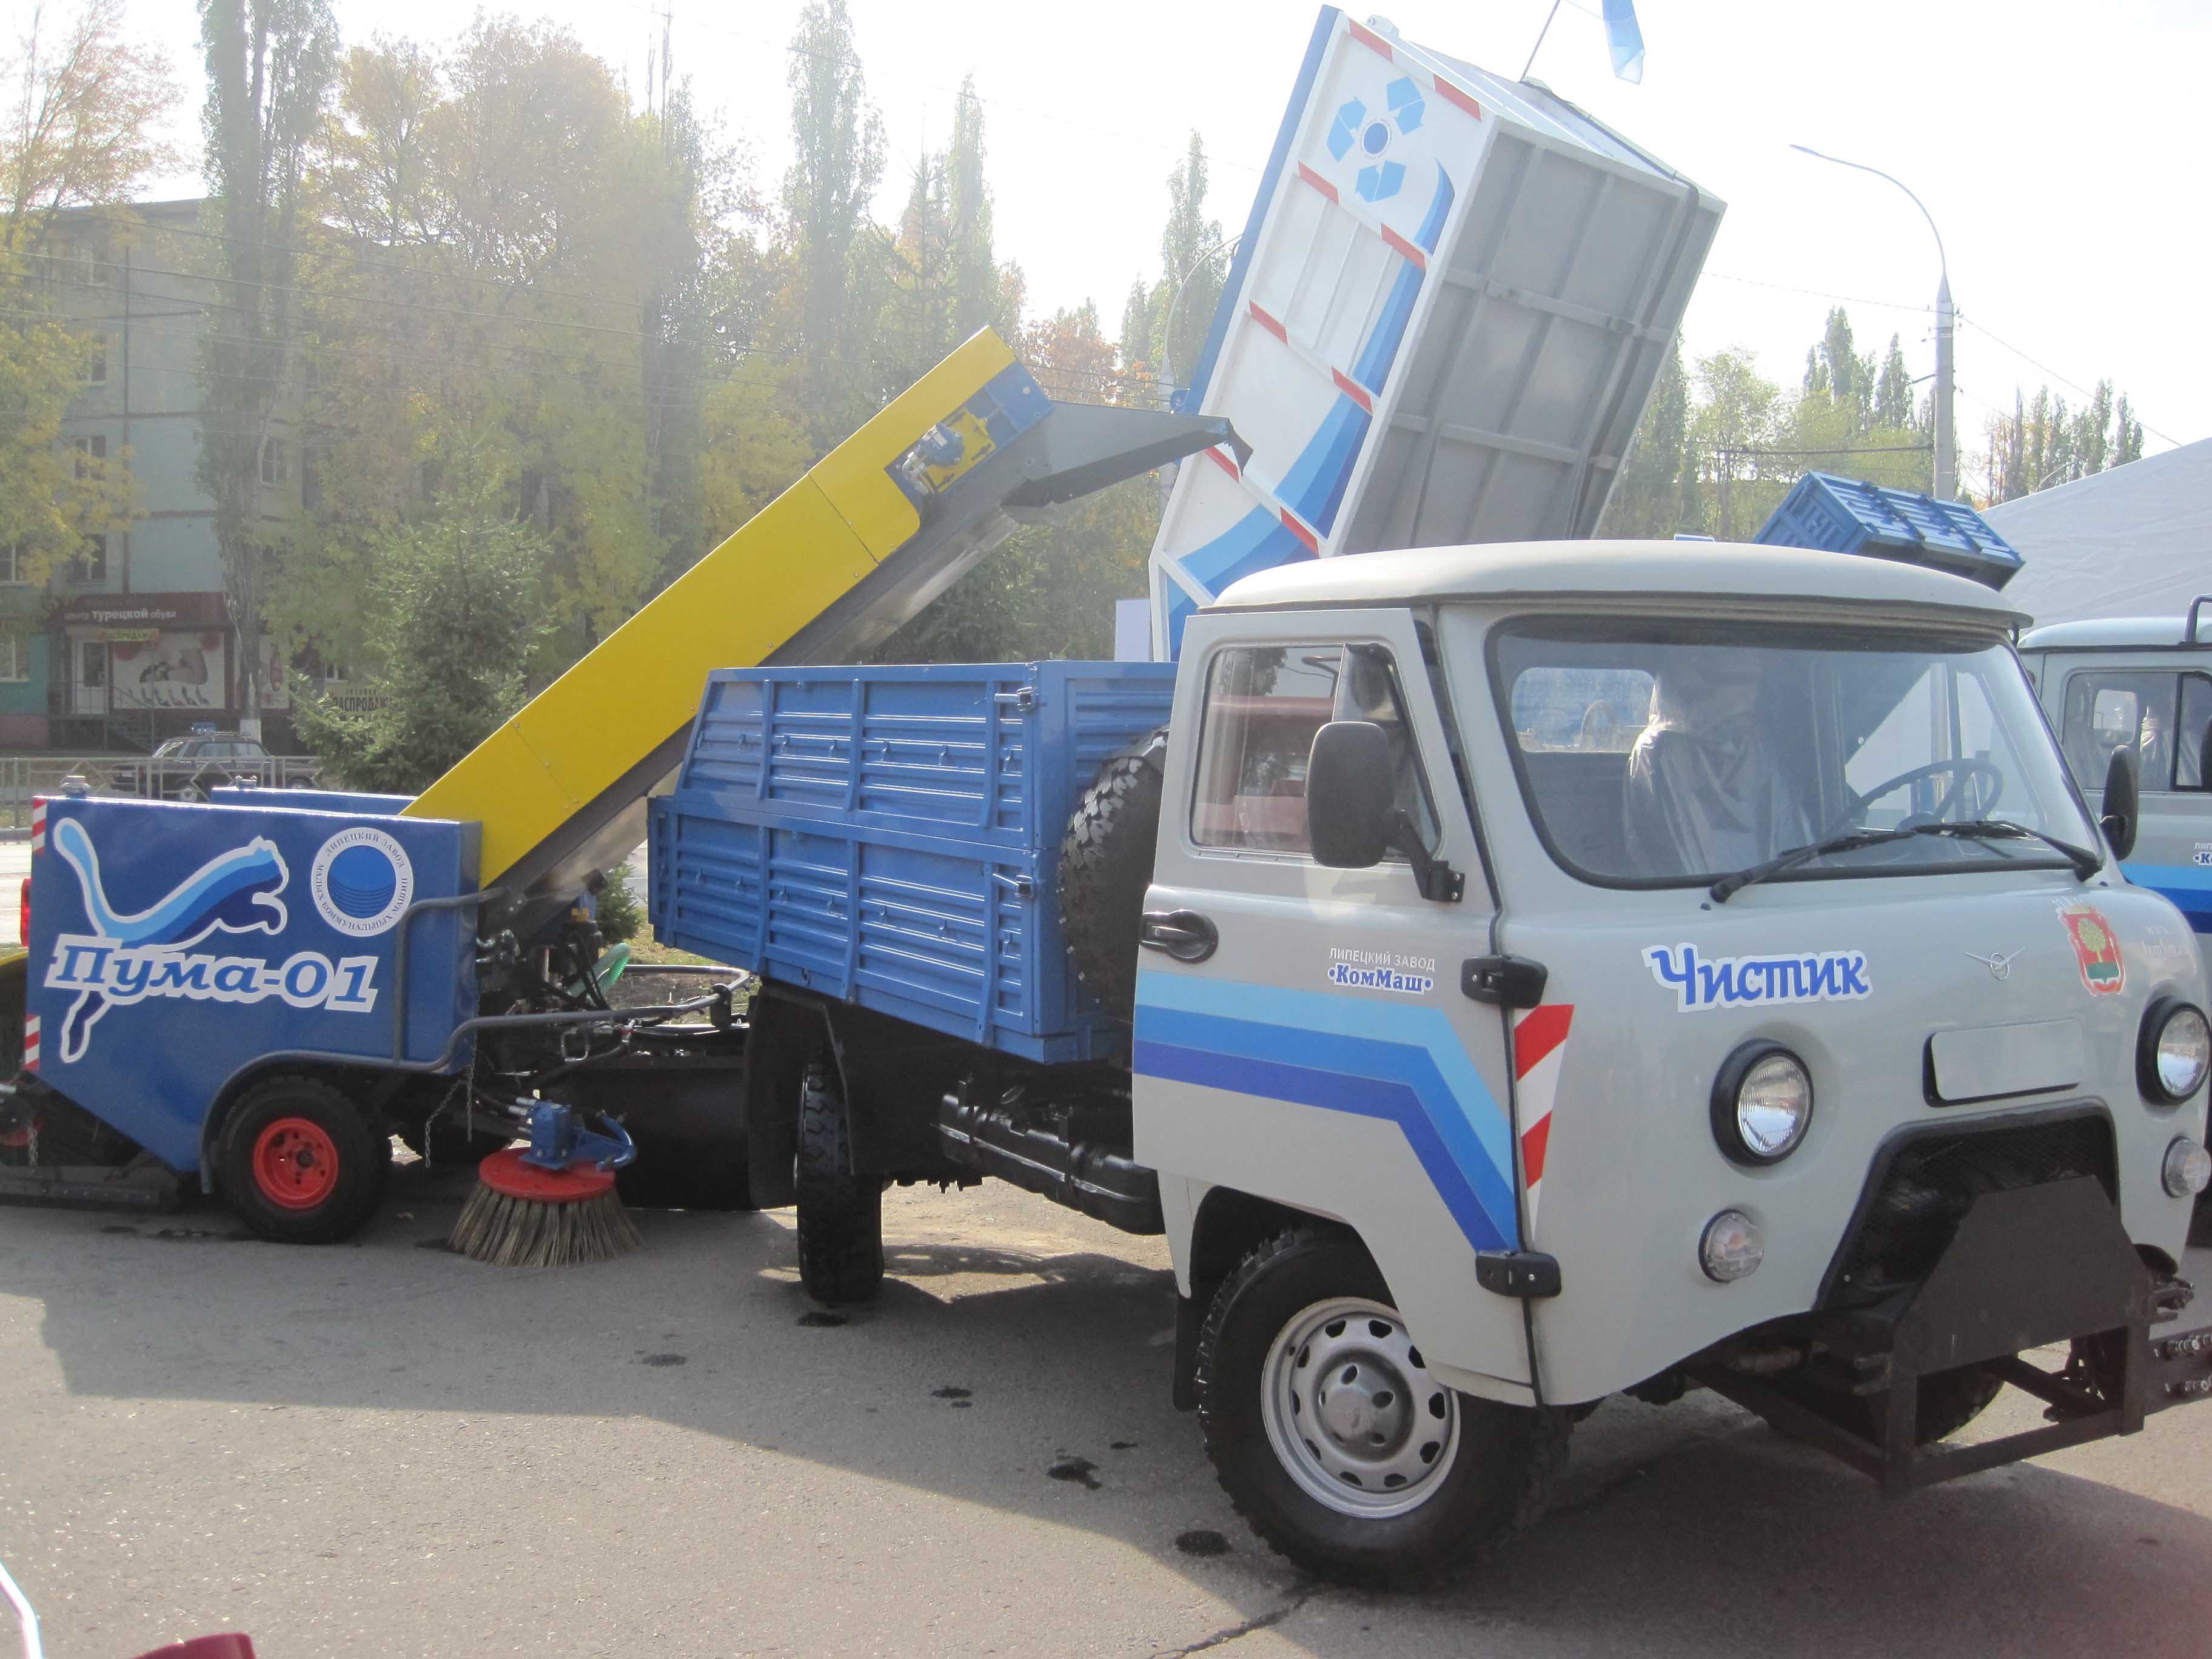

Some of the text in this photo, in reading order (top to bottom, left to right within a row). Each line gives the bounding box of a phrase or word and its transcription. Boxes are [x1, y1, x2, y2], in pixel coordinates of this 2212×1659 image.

[92, 608, 148, 621] турецкой
[150, 609, 176, 620] обуви
[325, 833, 404, 868] ЛИПЕЦКИЙ ЗАВОД
[316, 863, 407, 931] МАЛЫХ КОММУНАЛЬНЫХ МАШИН
[53, 943, 372, 1007] Пума-01
[1329, 947, 1435, 973] ЛИПЕЦКИЙ ЗАВОД
[1649, 947, 1869, 1006] Чистик
